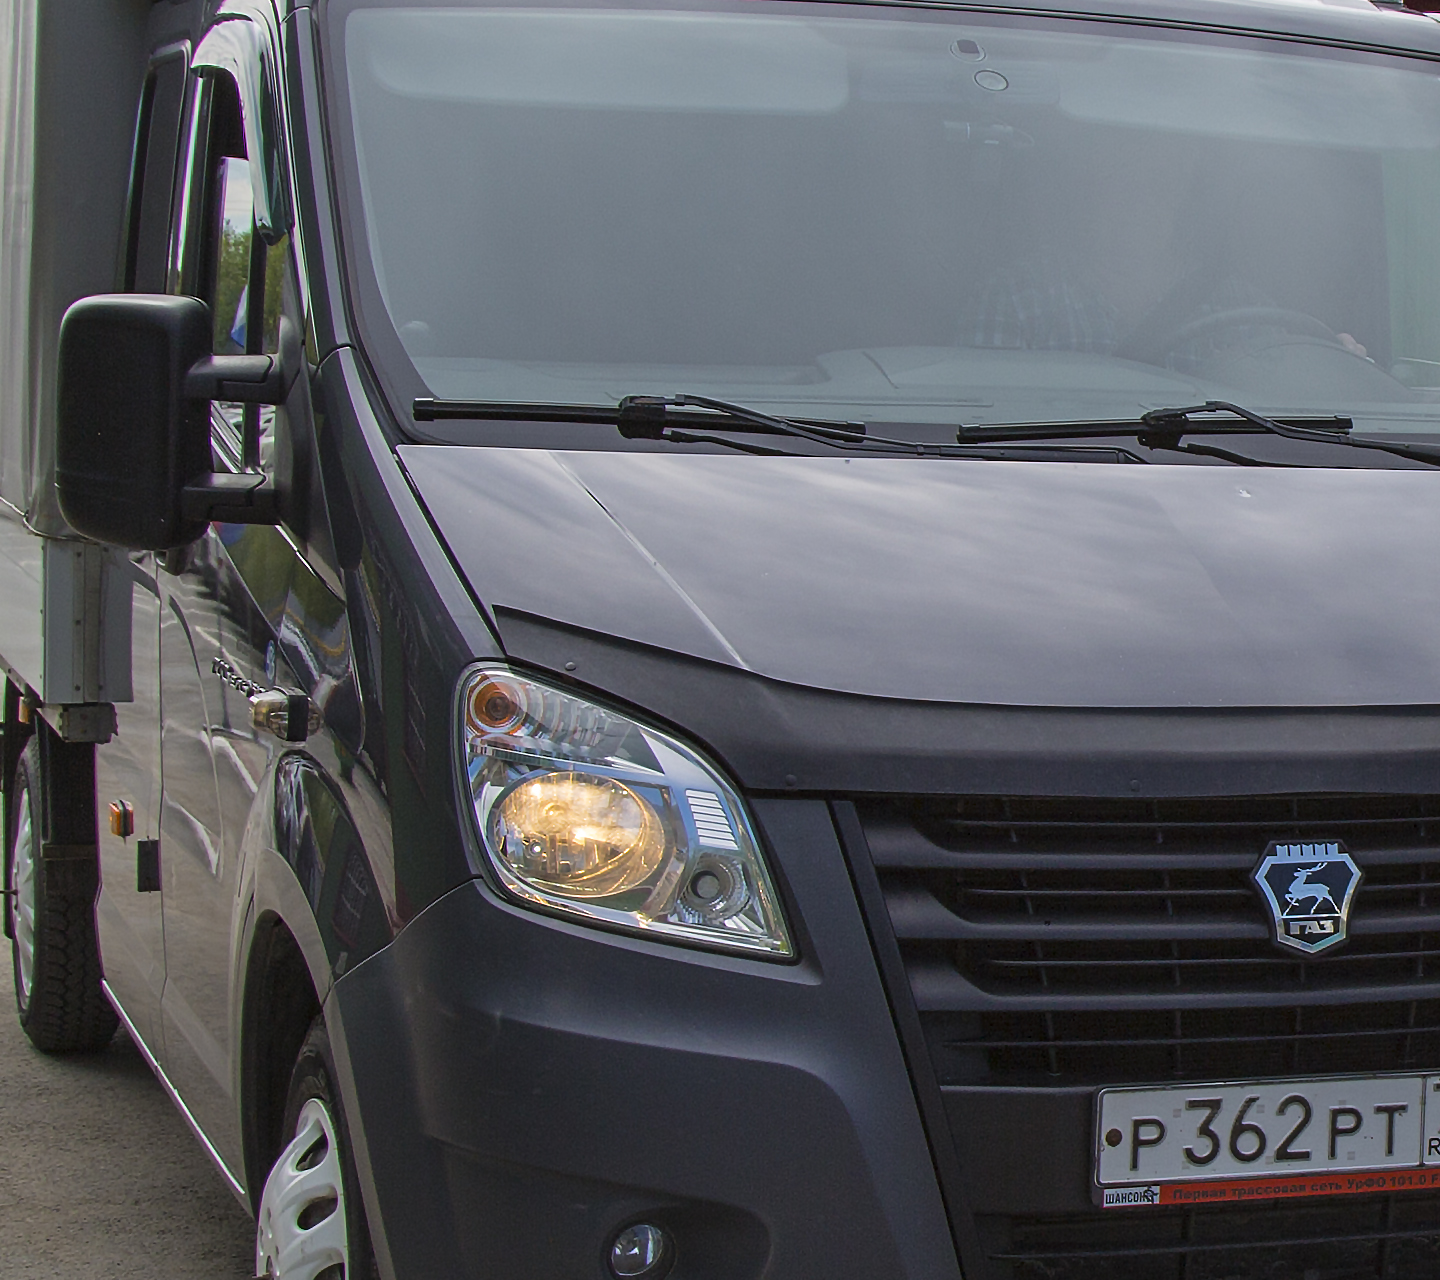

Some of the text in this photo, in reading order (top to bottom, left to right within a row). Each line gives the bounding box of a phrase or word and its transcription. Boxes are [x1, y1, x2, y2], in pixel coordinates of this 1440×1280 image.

[1290, 920, 1333, 934] ГАЗ
[1310, 1181, 1342, 1192] сеть
[1347, 1177, 1387, 1192] УрФО
[1390, 1174, 1427, 1188] 101.0
